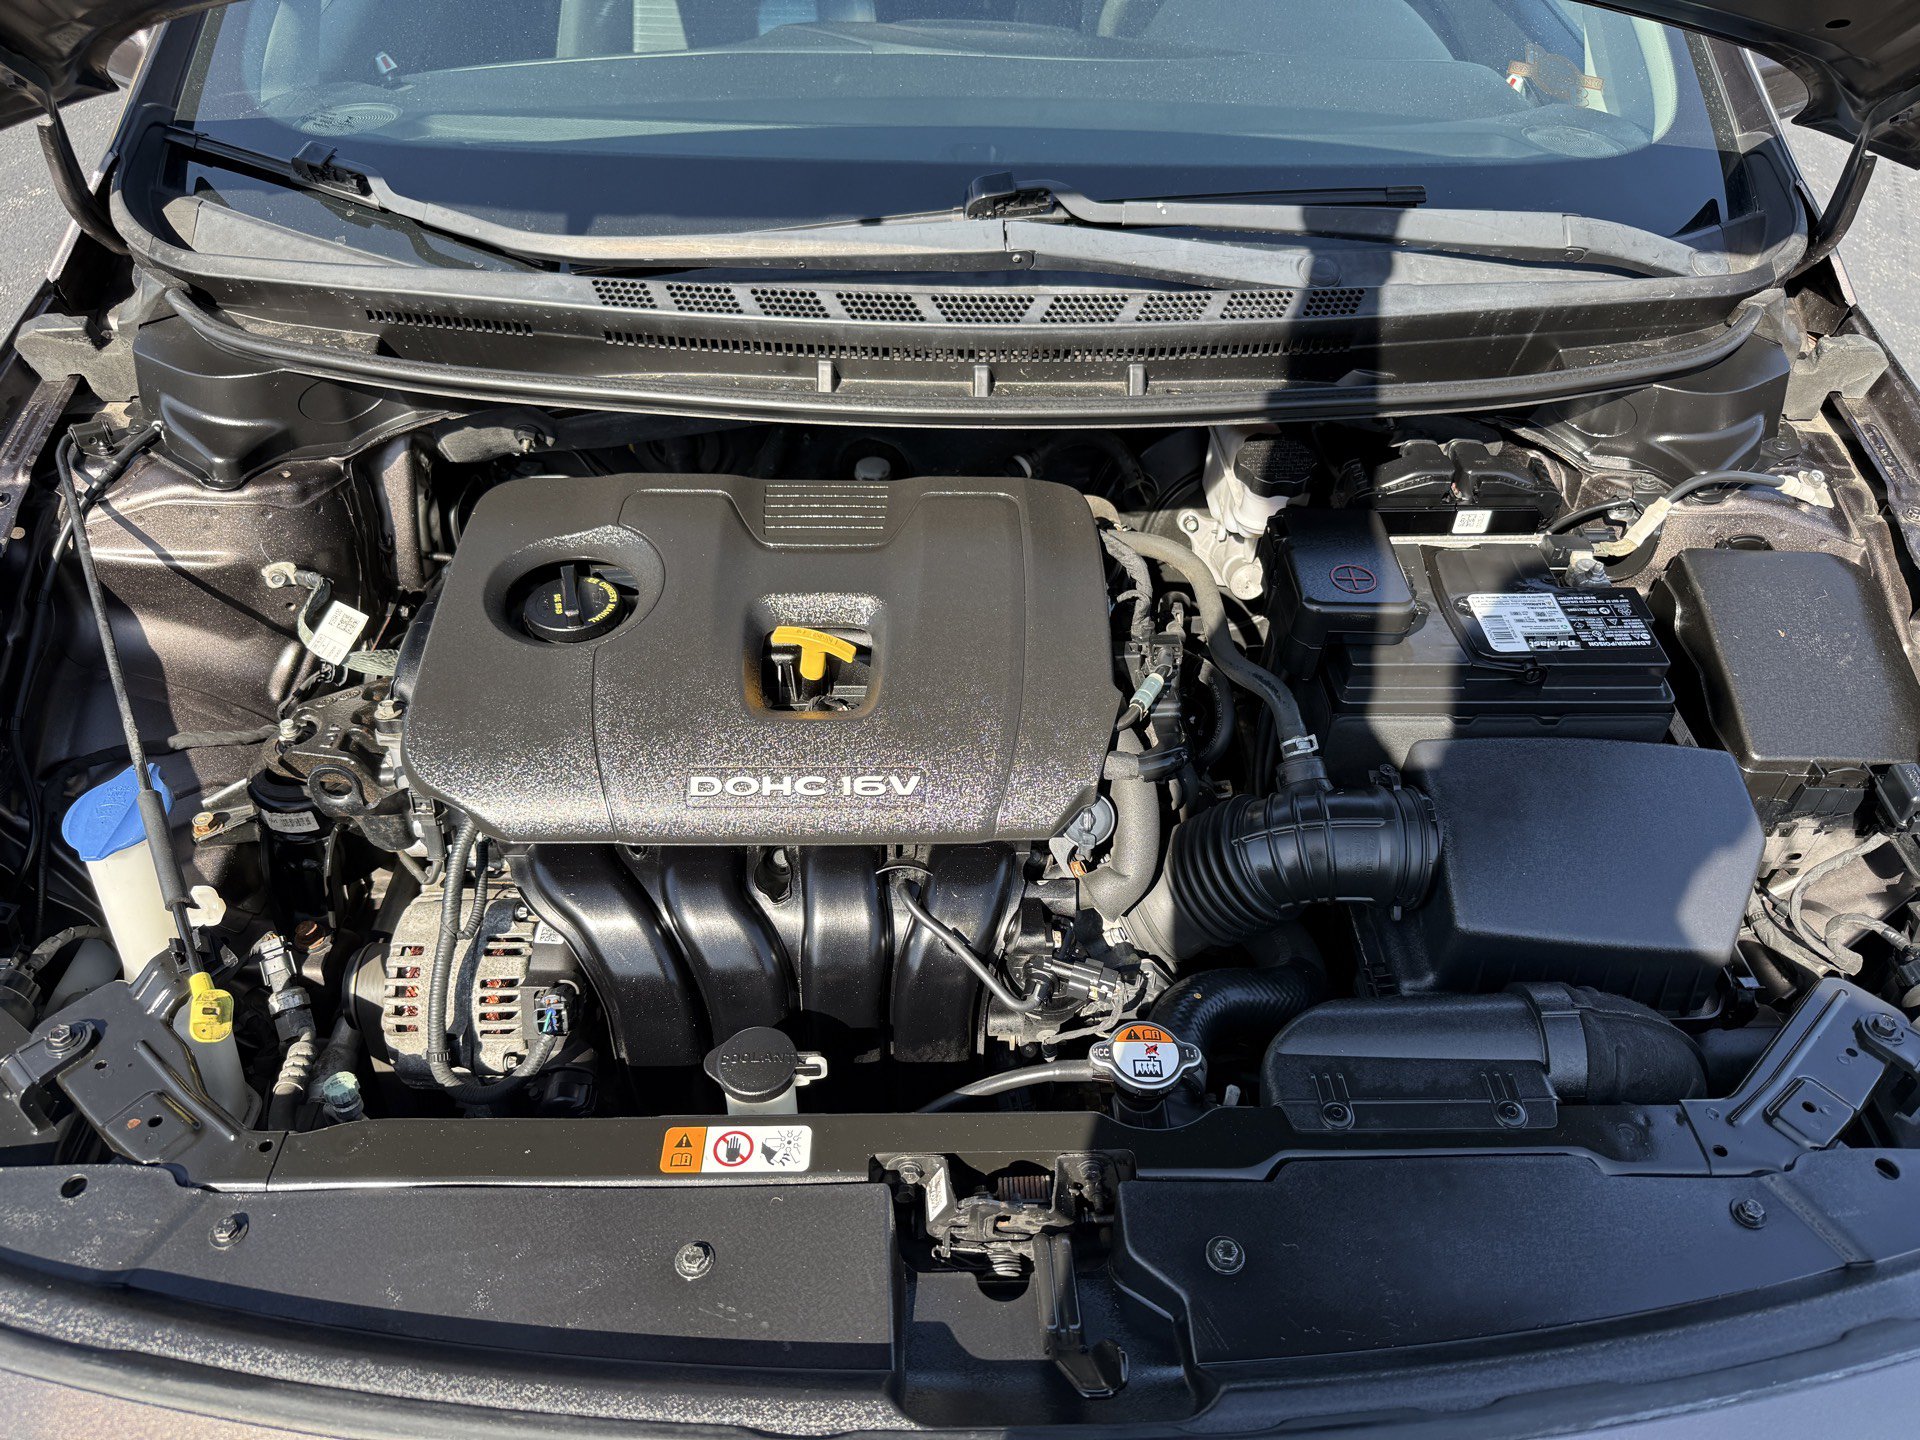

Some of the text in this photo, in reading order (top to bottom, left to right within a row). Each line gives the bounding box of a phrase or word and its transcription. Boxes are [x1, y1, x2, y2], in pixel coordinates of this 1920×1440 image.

[588, 603, 616, 623] MANUAL
[1528, 640, 1579, 649] Duralast
[690, 775, 921, 797] DOHC 16V
[721, 1052, 796, 1066] COOLANT
[1092, 1048, 1110, 1057] HCC
